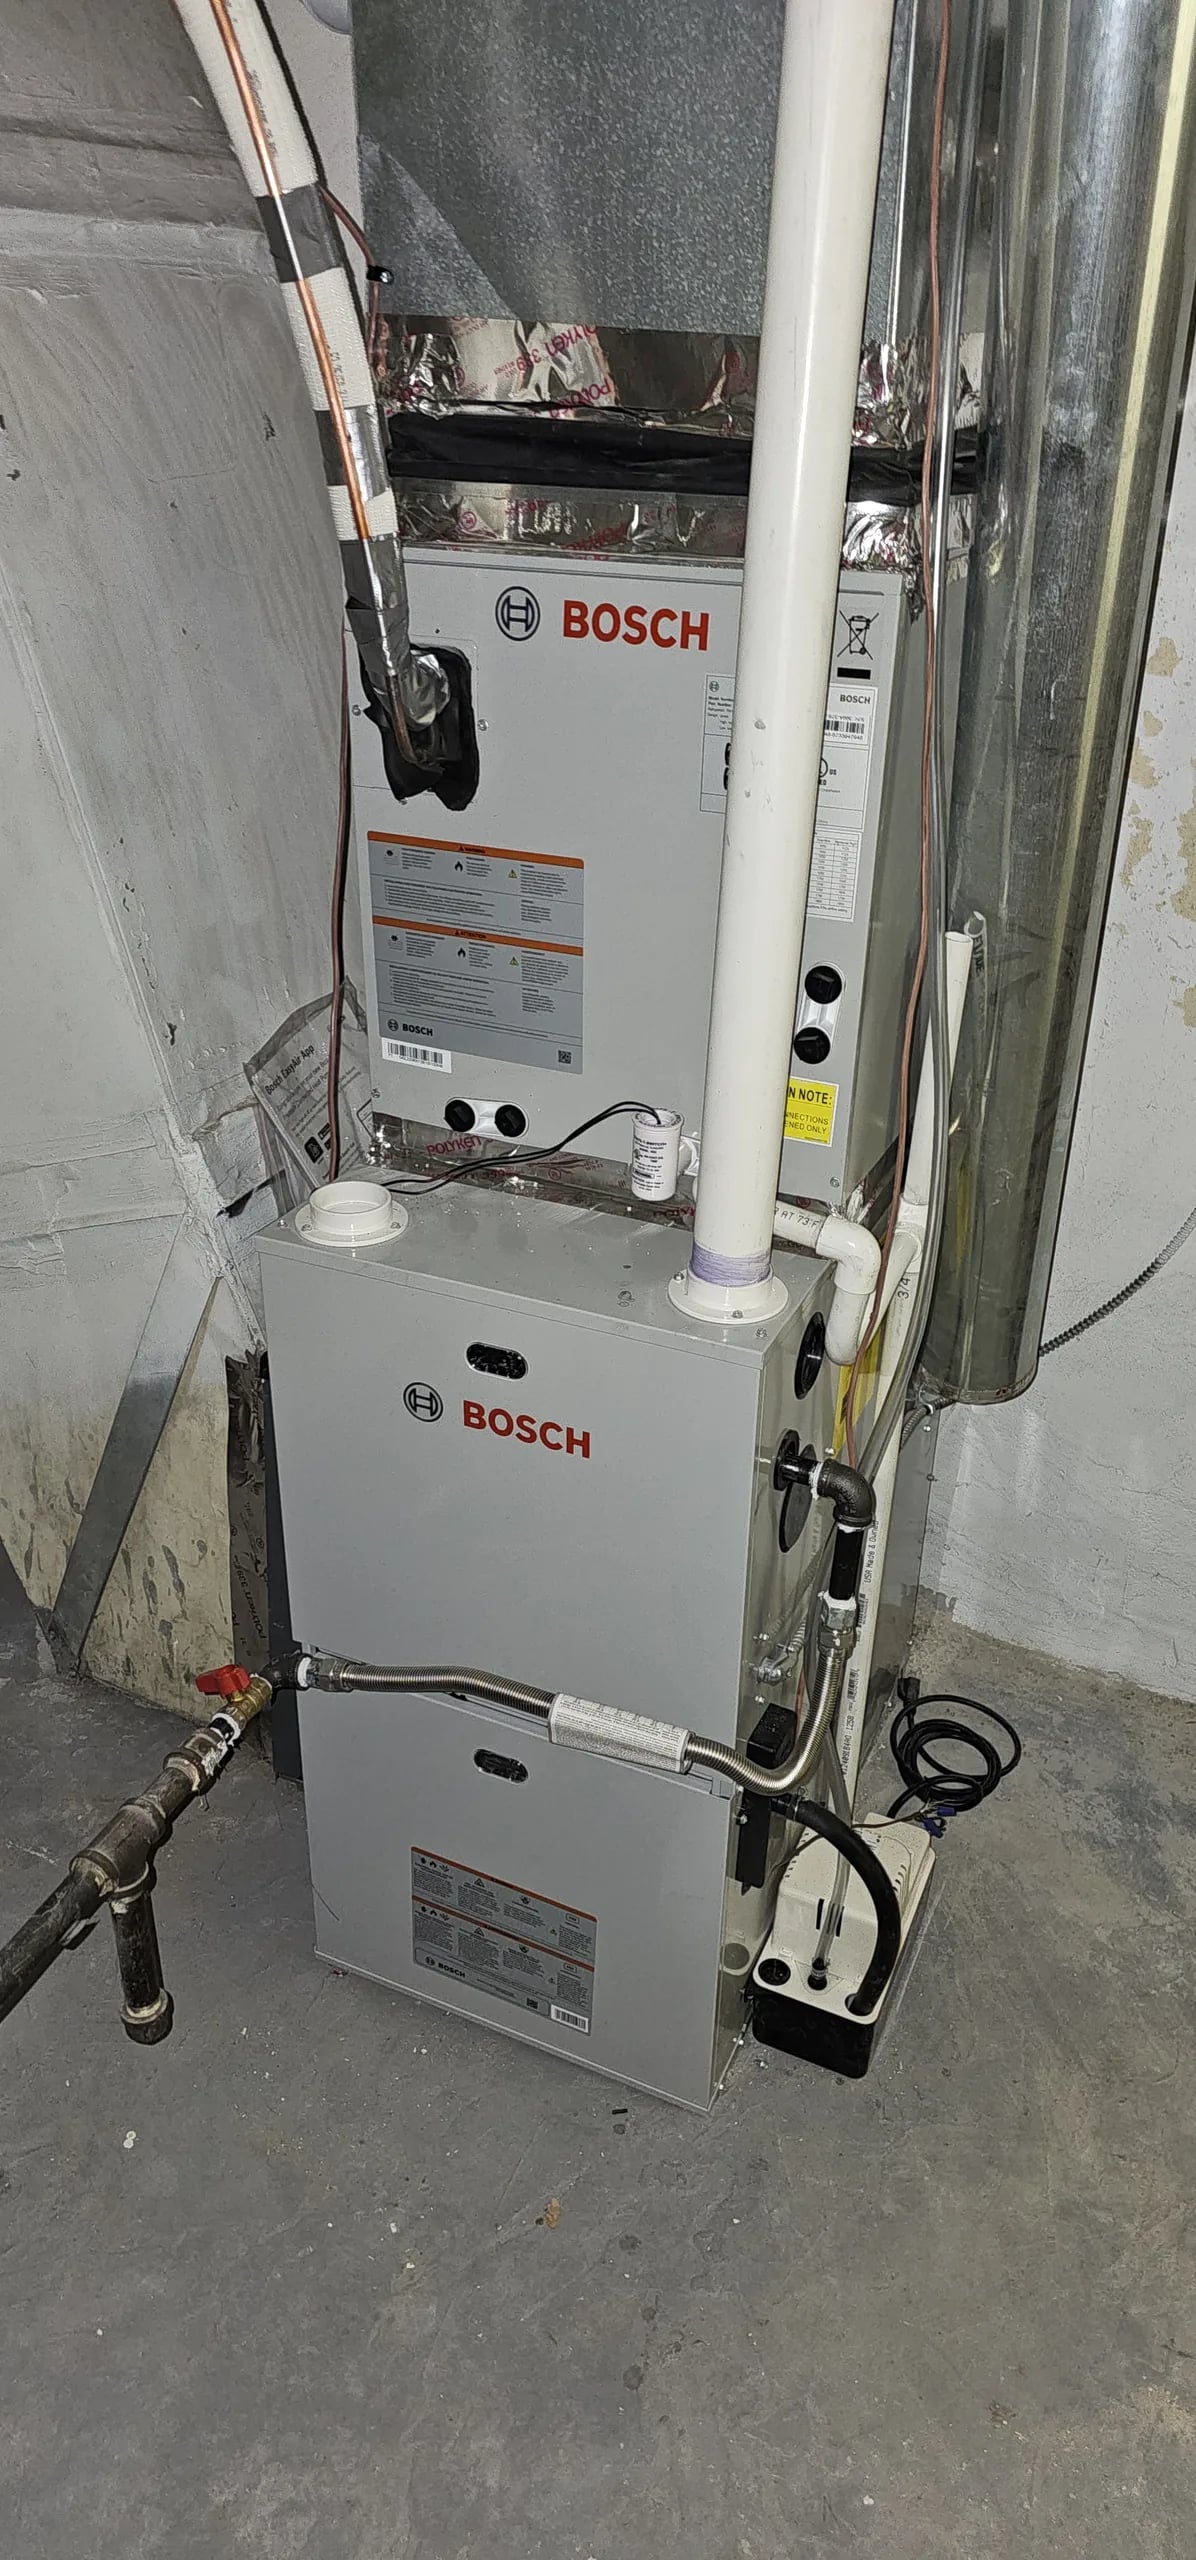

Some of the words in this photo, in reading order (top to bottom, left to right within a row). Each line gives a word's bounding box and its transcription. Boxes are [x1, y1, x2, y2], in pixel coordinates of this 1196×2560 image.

[545, 324, 598, 358] OLYKEN
[563, 599, 710, 651] BOSCH
[840, 694, 870, 704] BOSCH
[402, 1023, 433, 1037] BOSCH
[264, 1074, 283, 1095] Bosch
[281, 1055, 302, 1079] EasyAir
[300, 1045, 315, 1060] App
[788, 1086, 795, 1099] N
[799, 1088, 833, 1105] NOTE:
[787, 1112, 829, 1125] NECTIONS
[785, 1121, 805, 1130] ENED
[806, 1124, 827, 1134] ONLY
[781, 1210, 795, 1221] AT
[898, 1277, 911, 1300] 3/4
[463, 1399, 590, 1459] BOSCH
[866, 1550, 875, 1568] Made
[864, 1570, 872, 1583] USA
[438, 1962, 466, 1978] BOSCH
